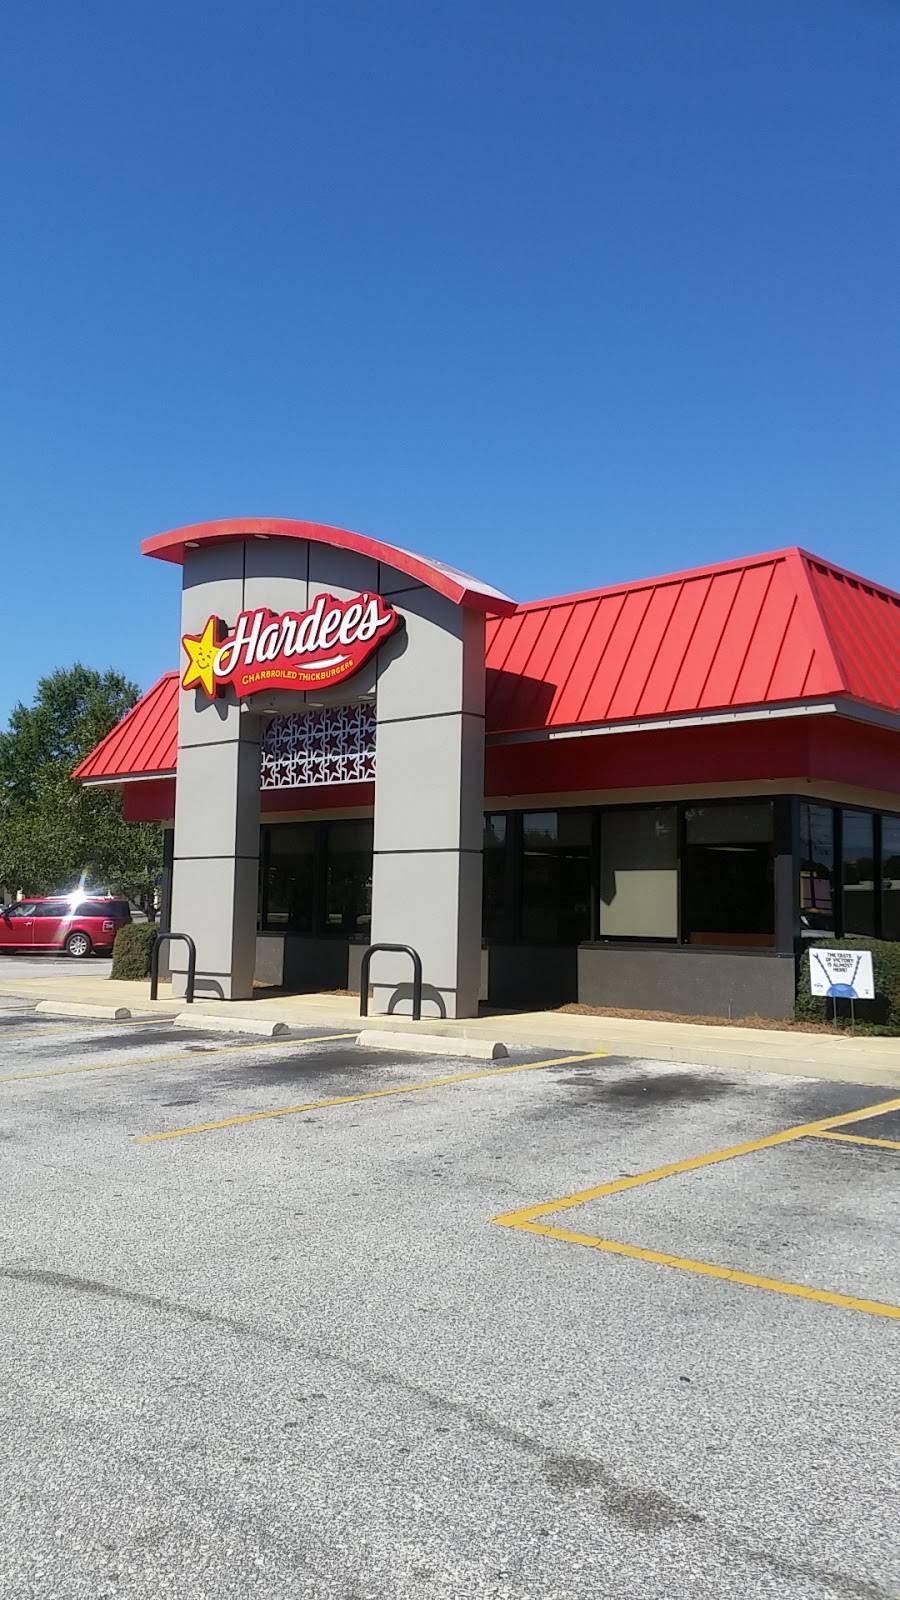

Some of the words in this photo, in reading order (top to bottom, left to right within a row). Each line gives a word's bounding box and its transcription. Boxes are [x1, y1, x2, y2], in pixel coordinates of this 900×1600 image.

[213, 594, 392, 677] Hardee's
[241, 668, 297, 685] CHARBROILED
[298, 660, 354, 681] THICKBURGERS
